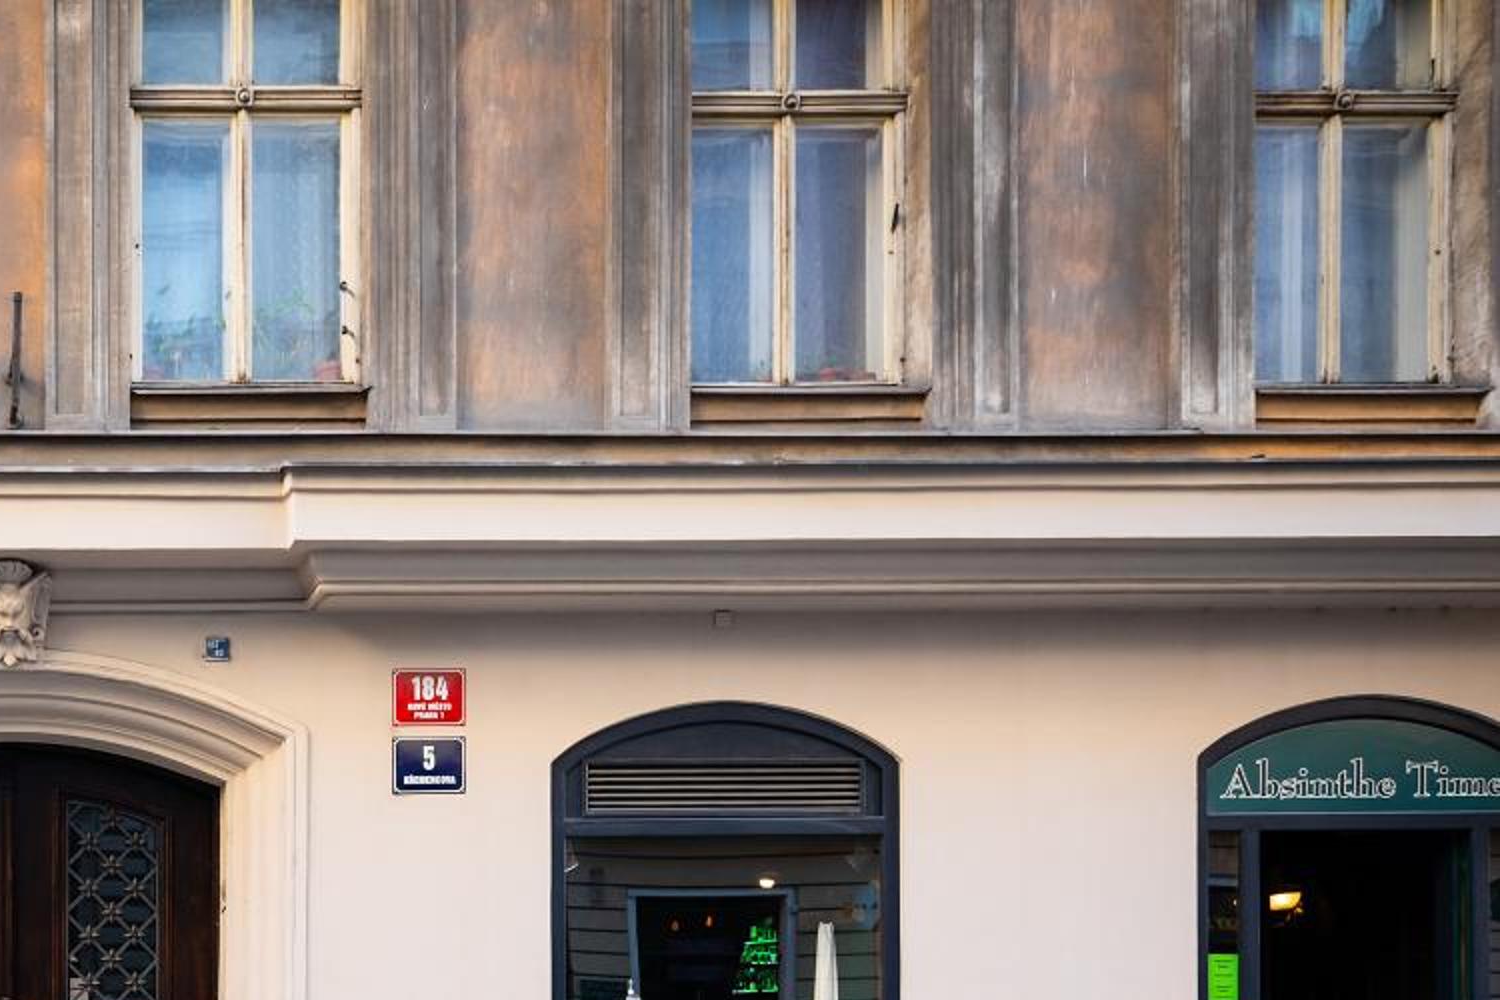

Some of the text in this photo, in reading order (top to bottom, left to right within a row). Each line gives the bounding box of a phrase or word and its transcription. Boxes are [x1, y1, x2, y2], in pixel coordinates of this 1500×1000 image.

[411, 676, 448, 701] 184
[423, 745, 435, 771] 5
[1220, 757, 1397, 800] Absinthe
